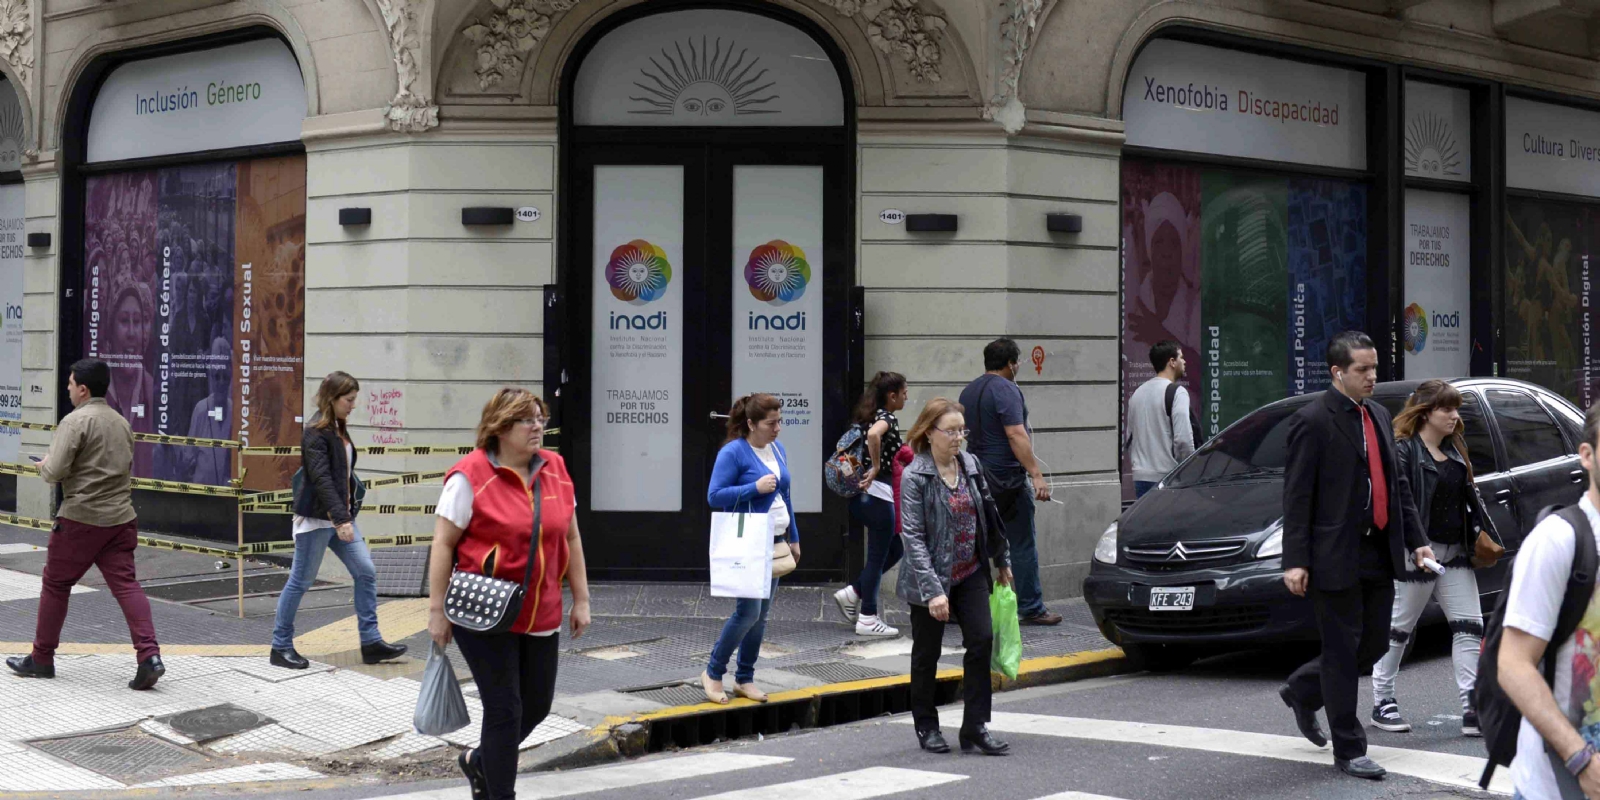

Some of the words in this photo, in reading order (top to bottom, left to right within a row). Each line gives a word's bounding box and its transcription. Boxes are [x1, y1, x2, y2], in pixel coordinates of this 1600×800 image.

[136, 86, 198, 115] Inclusión
[207, 80, 261, 106] Género
[1144, 76, 1228, 111] Xenofobia
[1238, 90, 1339, 126] Discapacidad
[1523, 132, 1564, 157] Cultura
[1410, 224, 1450, 239] TRABAJAMOS
[1419, 239, 1430, 250] POR
[1431, 240, 1442, 250] TUS
[1410, 251, 1450, 267] DERECHOS
[160, 246, 171, 317] Género
[1582, 255, 1591, 307] Digital
[241, 262, 252, 333] Sexual
[89, 265, 99, 357] Indígenas
[610, 311, 667, 330] inadi
[749, 311, 806, 330] inadi
[1432, 310, 1460, 328] inadi
[160, 322, 170, 346] de
[1209, 326, 1221, 437] scapacidad
[606, 389, 669, 401] TRABAJAMOS
[787, 398, 809, 408] 2345
[620, 402, 637, 410] POR
[640, 402, 656, 410] TUS
[606, 412, 669, 424] DERECHOS
[1173, 593, 1193, 606] 243
